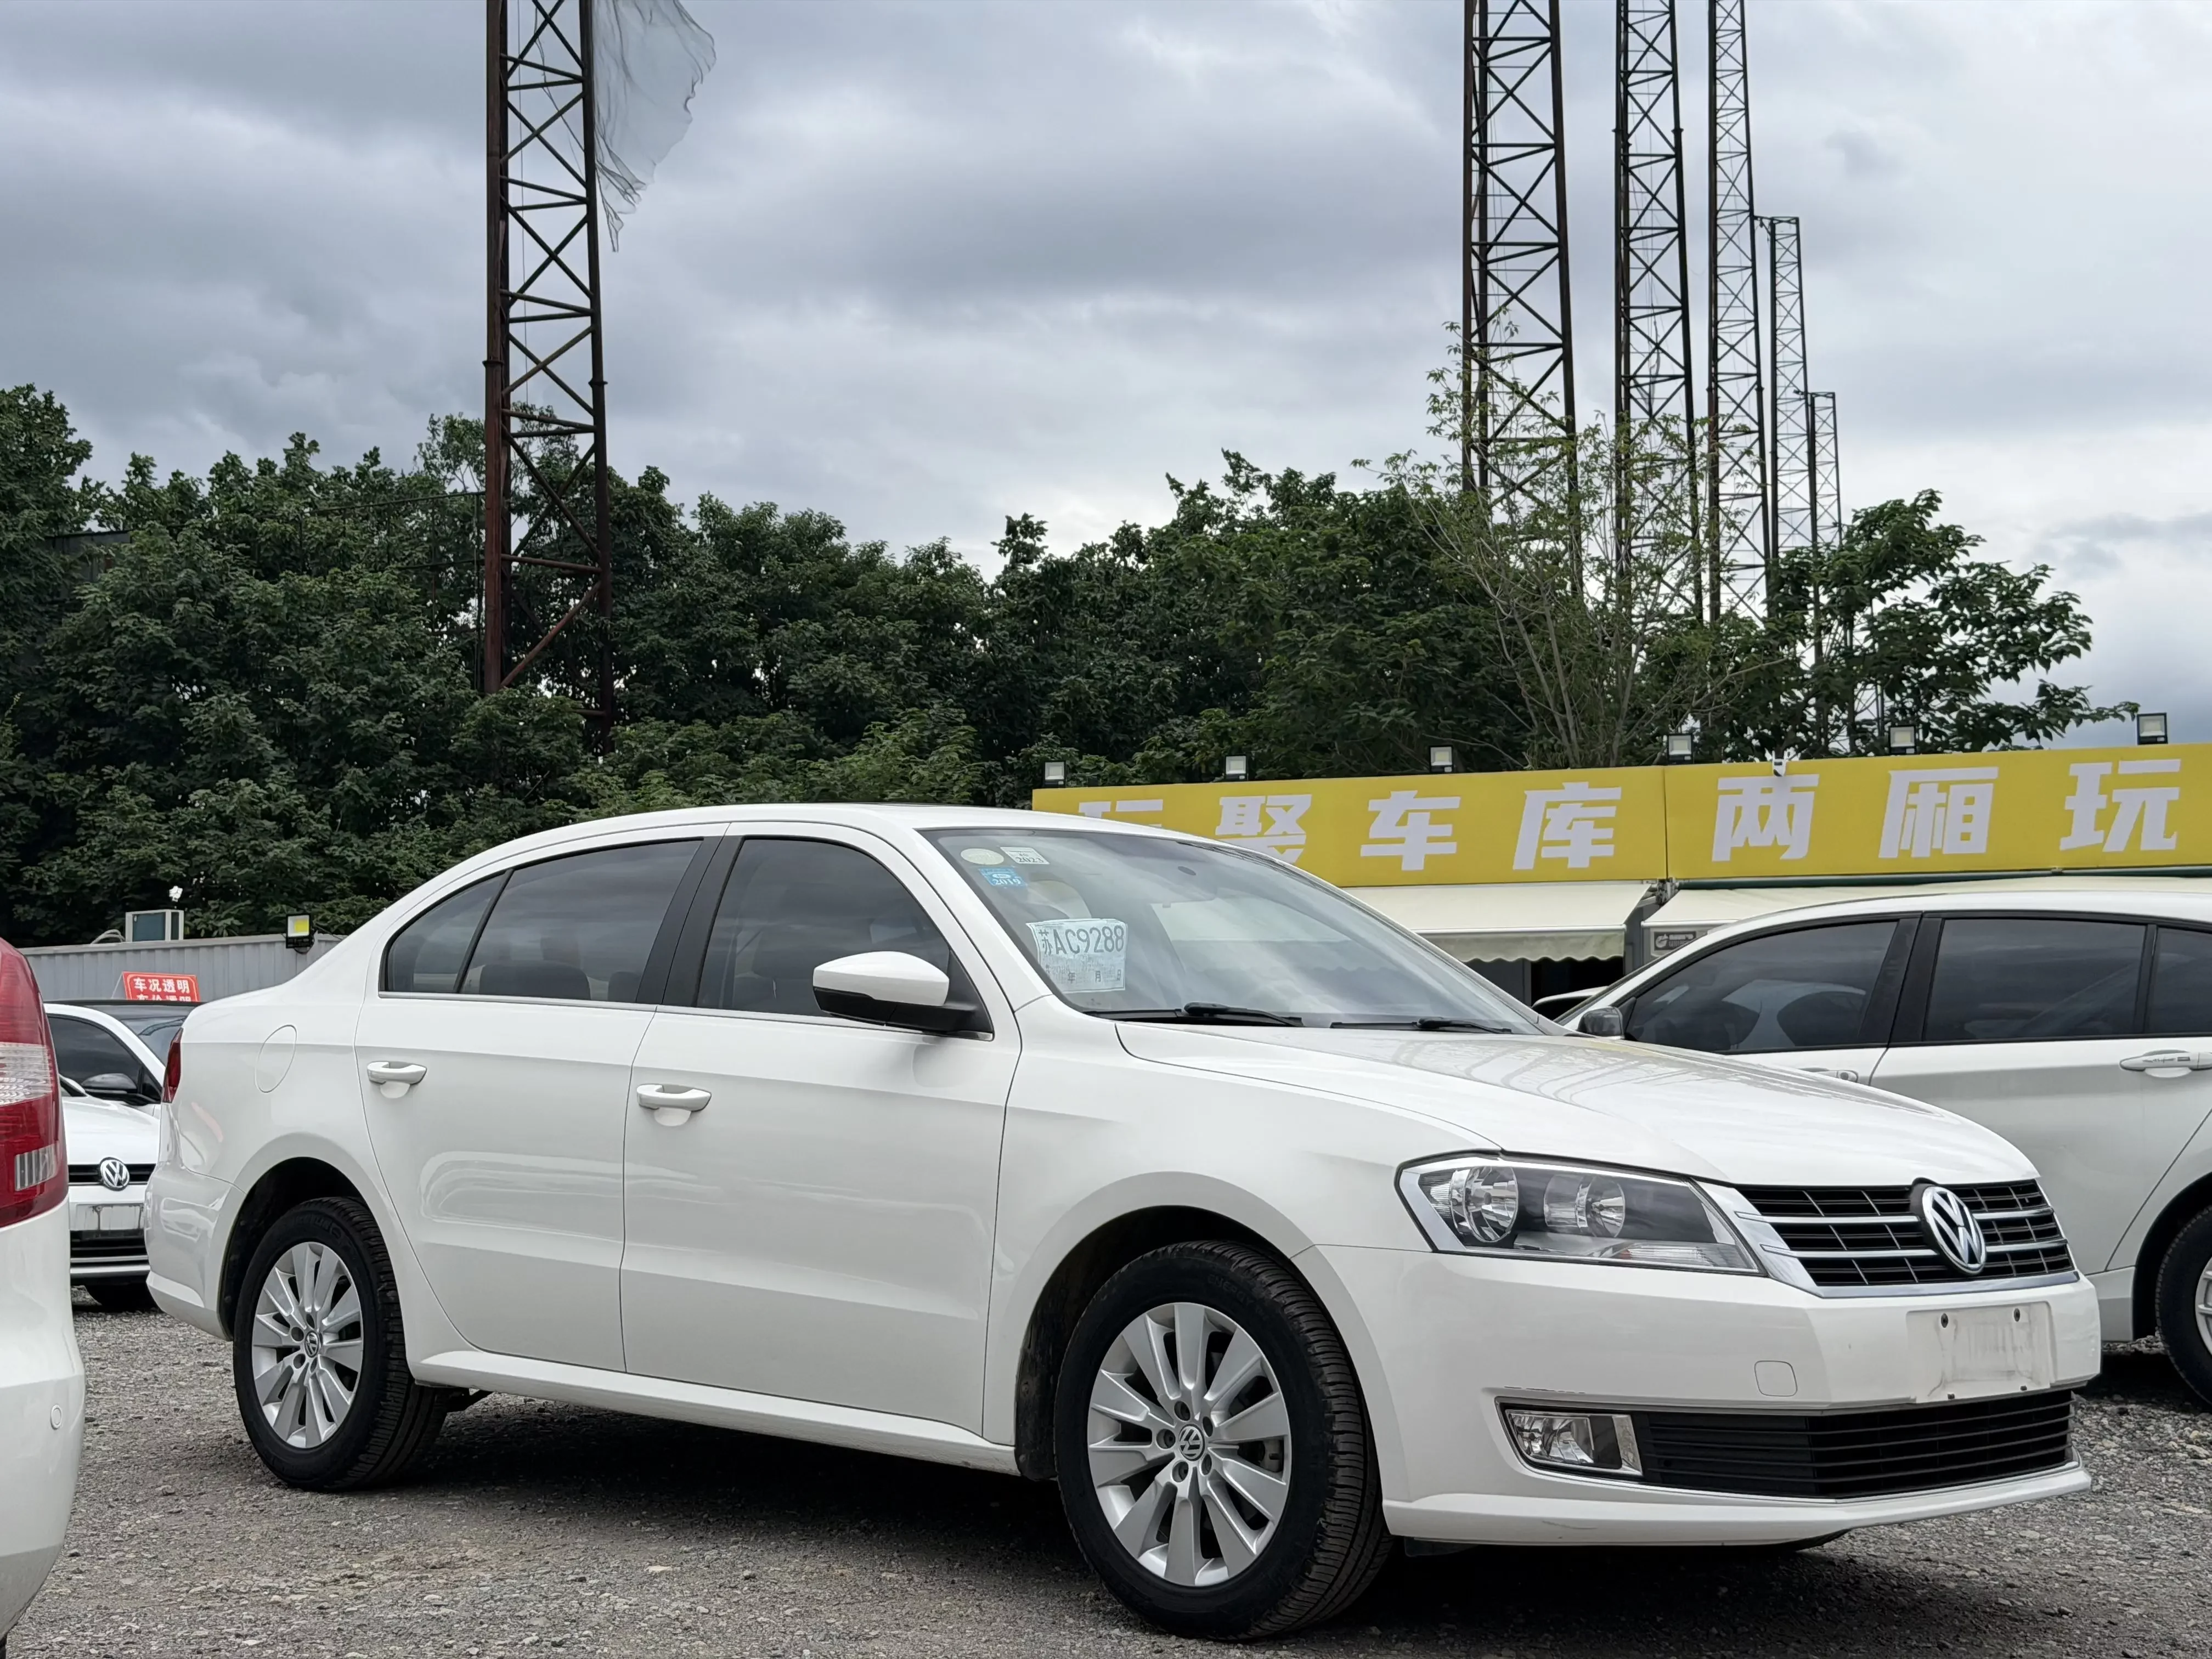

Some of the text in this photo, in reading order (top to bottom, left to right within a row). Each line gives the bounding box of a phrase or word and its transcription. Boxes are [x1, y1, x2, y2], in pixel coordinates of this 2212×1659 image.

[1038, 925, 1125, 956] 苏AC9288
[133, 977, 191, 994] 车况透明
[1922, 1186, 1987, 1274] VW
